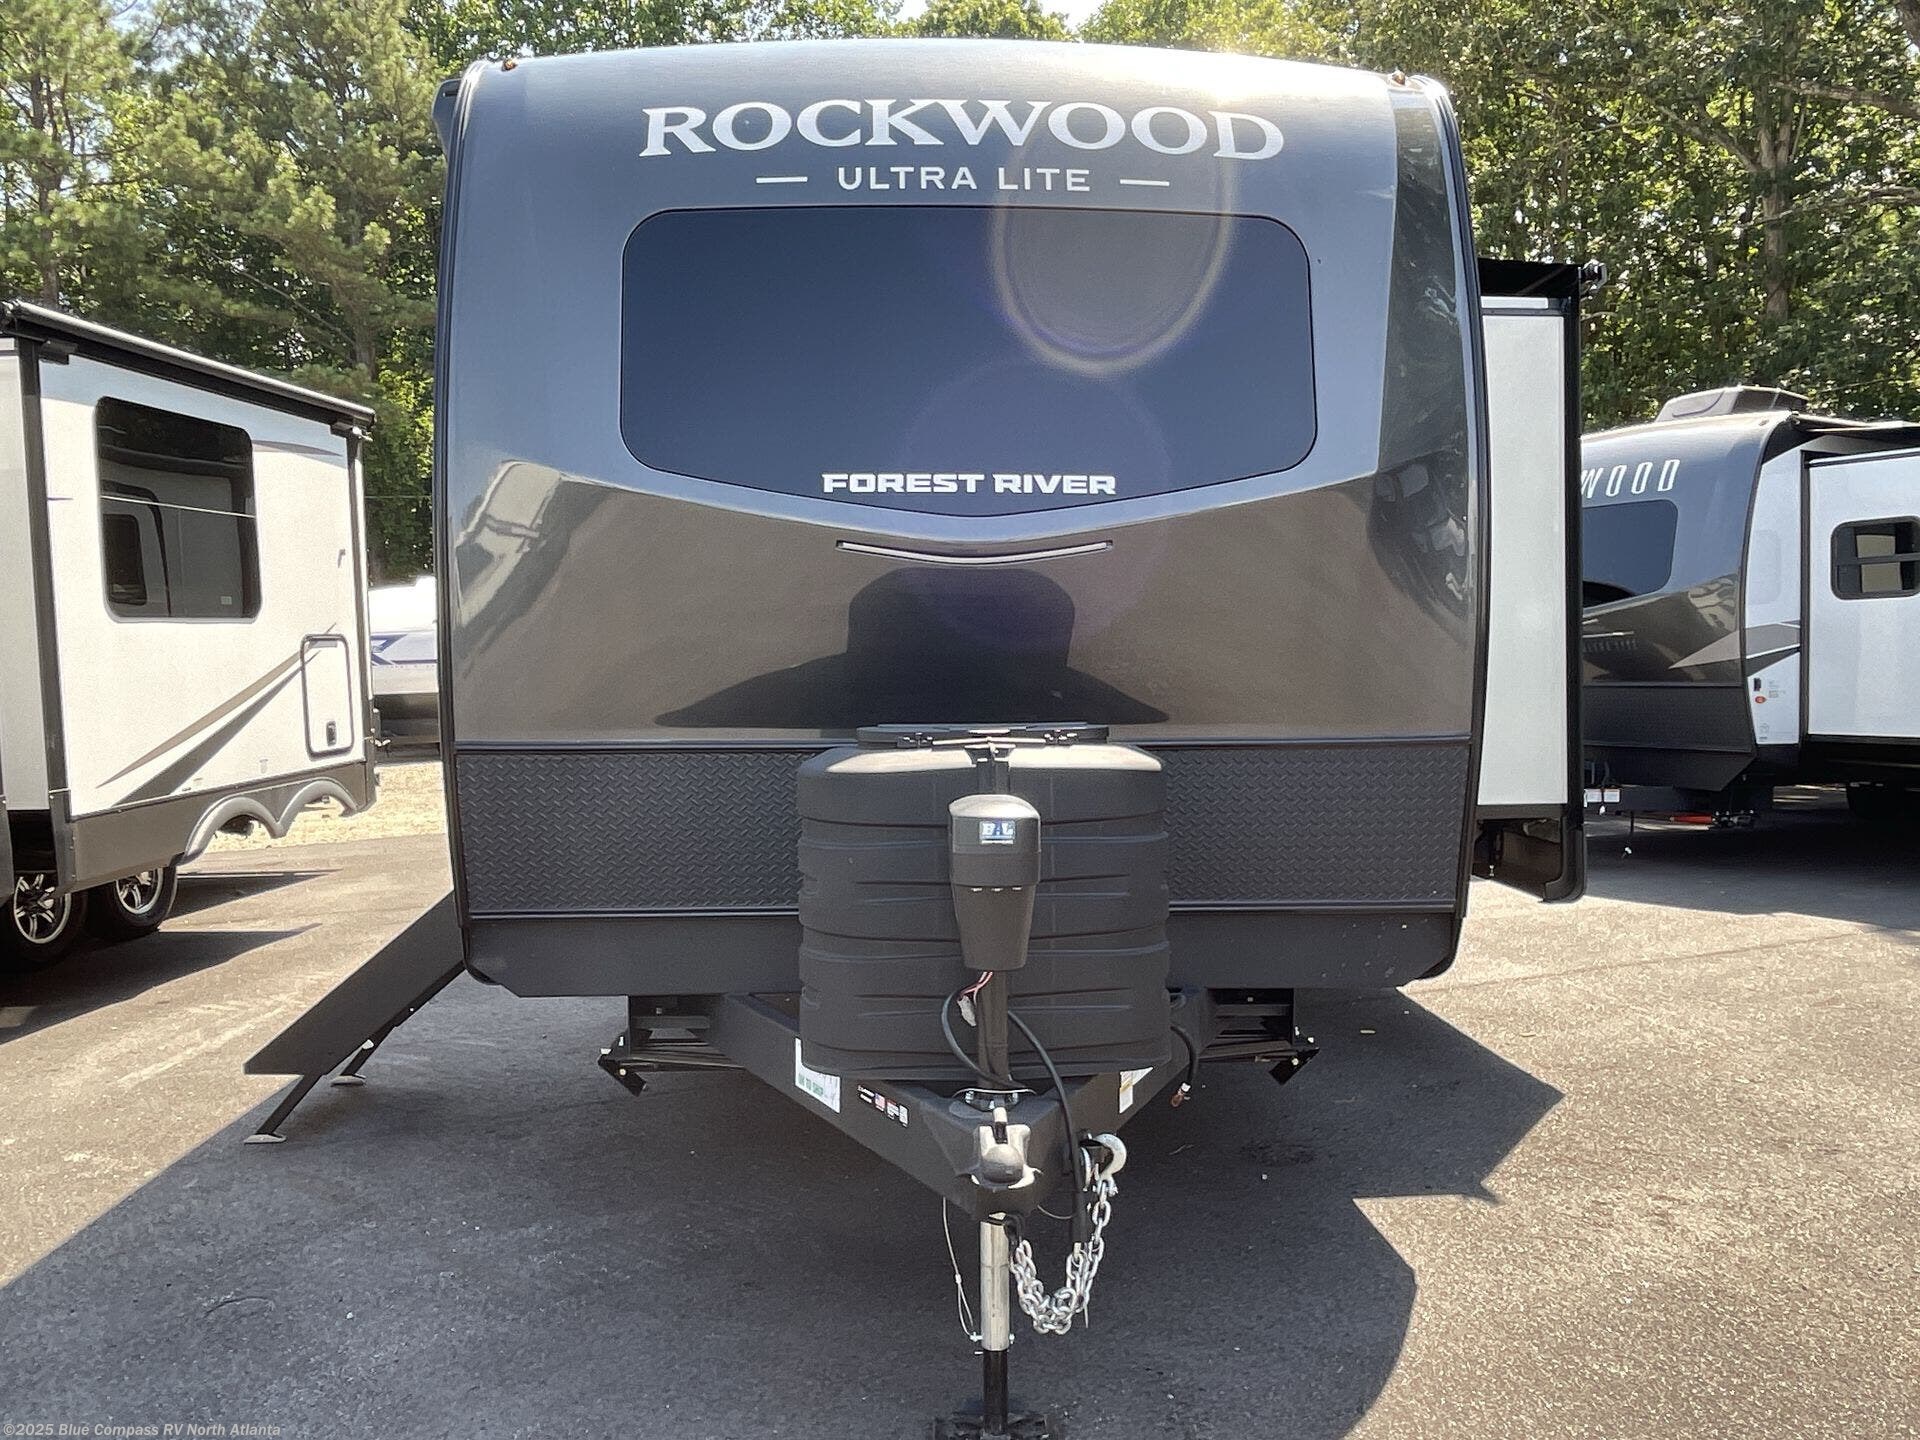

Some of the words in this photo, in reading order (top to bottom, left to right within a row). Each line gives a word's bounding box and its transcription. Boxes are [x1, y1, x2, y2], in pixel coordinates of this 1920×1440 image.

[639, 99, 1284, 160] ROCKWOOD
[838, 166, 978, 190] ULTRA
[998, 167, 1090, 192] LITE
[822, 473, 985, 493] FOREST
[992, 474, 1117, 495] RIVER
[982, 822, 1014, 836] BAL
